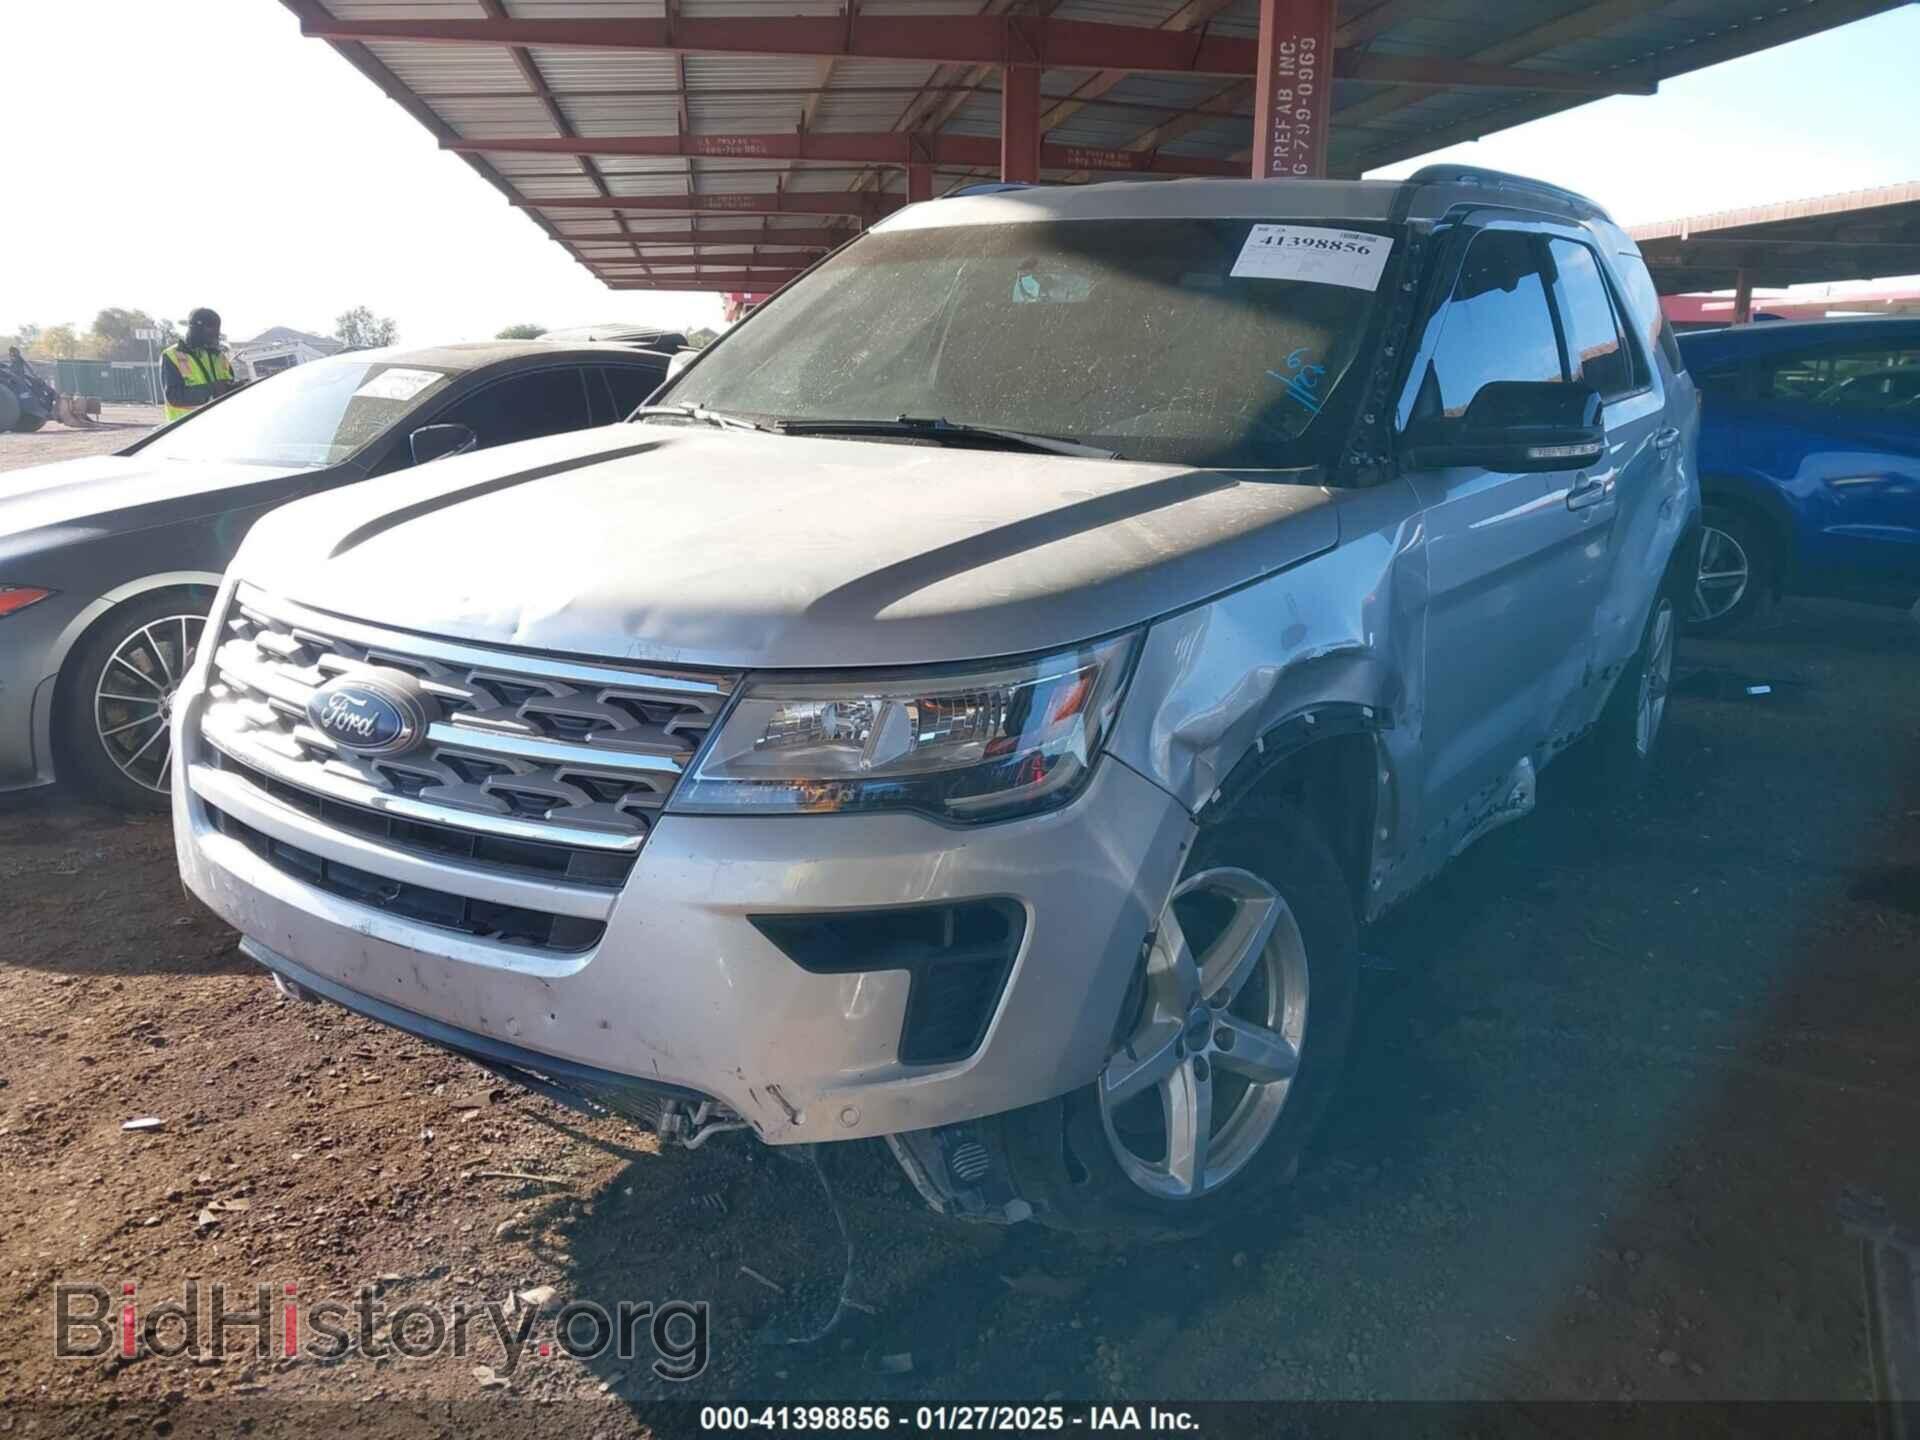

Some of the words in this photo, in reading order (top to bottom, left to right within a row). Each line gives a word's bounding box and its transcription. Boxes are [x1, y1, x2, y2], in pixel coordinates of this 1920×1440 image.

[1279, 34, 1297, 76] INC.
[1272, 88, 1294, 171] PREFAB
[1259, 235, 1371, 256] 41398856
[320, 691, 380, 737] Ford
